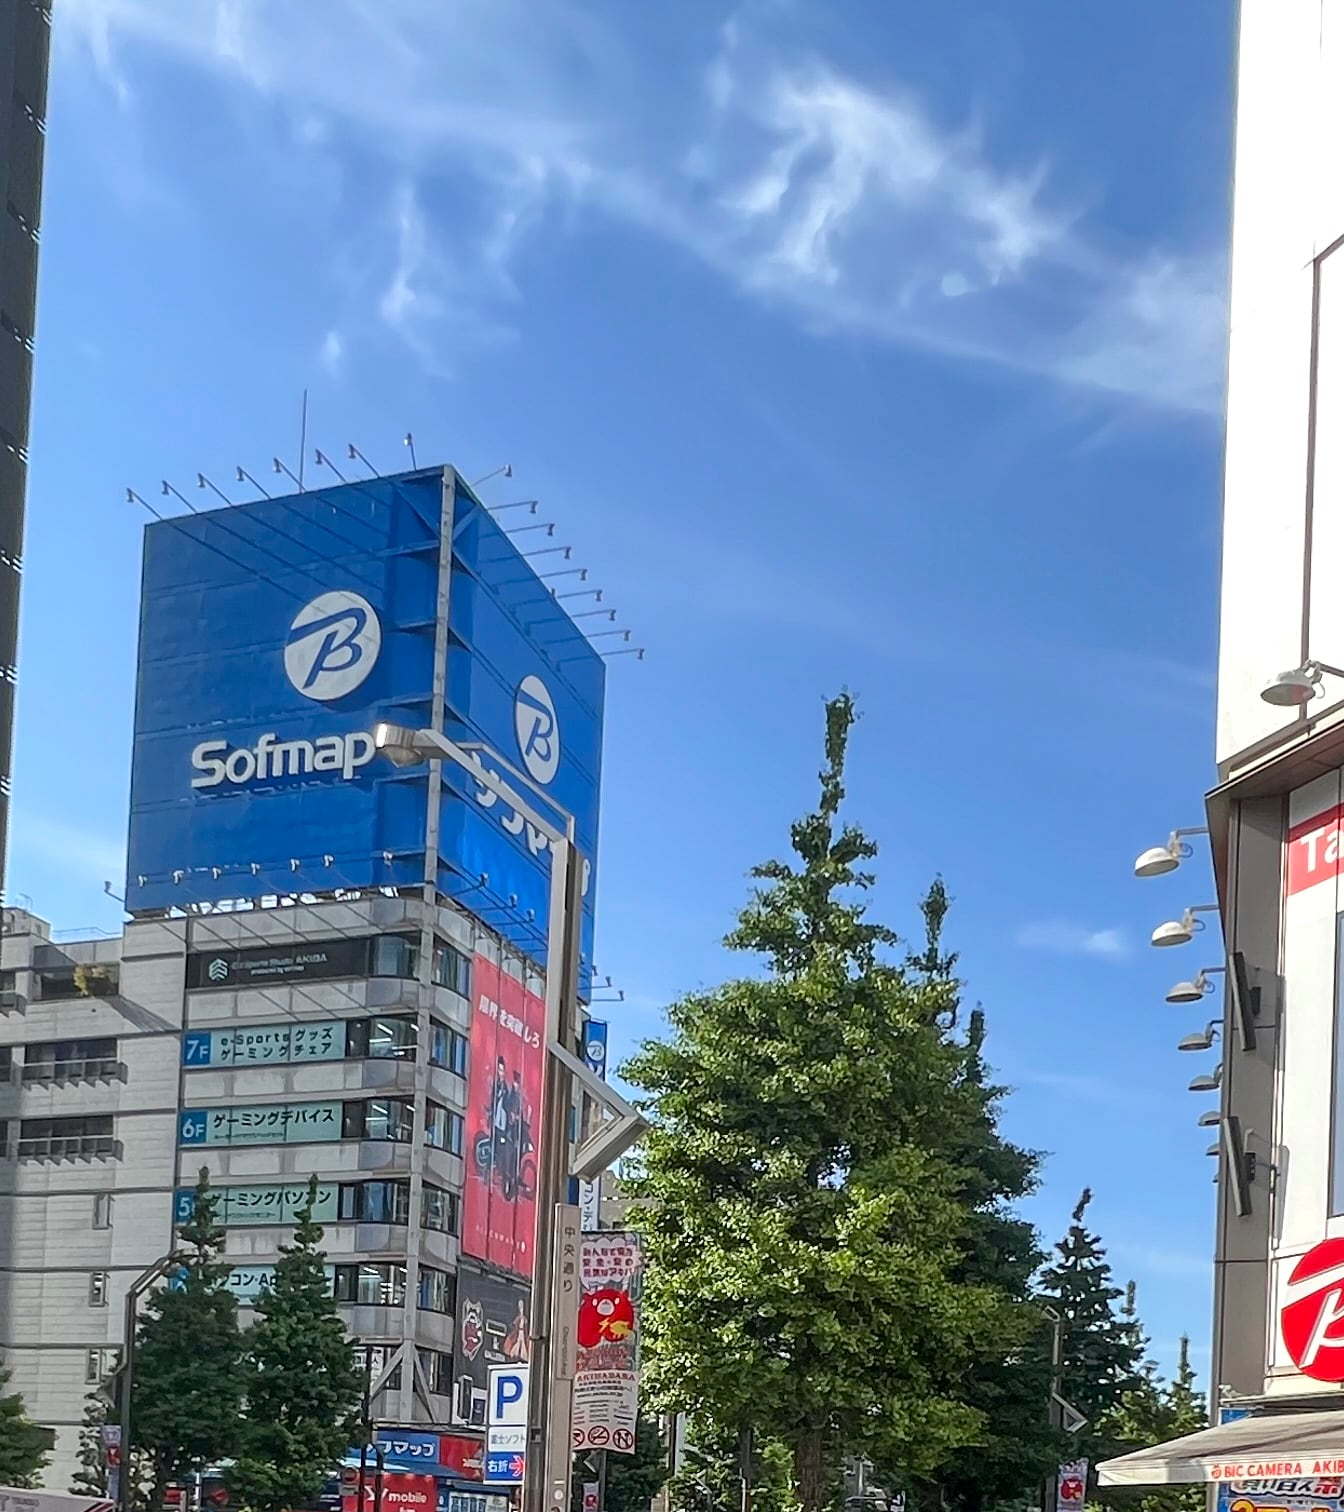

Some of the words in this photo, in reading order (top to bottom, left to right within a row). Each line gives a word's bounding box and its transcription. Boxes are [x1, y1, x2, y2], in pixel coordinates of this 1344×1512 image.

[190, 730, 376, 791] Sofmap
[294, 1027, 334, 1042] グッズ
[186, 1038, 209, 1061] 7F
[182, 1118, 206, 1140] 6F
[212, 1108, 336, 1130] ゲーミングデバイス
[562, 1225, 576, 1294] 中央通り
[496, 1375, 524, 1419] P
[490, 1434, 526, 1446] 富士ソフト
[487, 1459, 509, 1474] 右折
[1223, 1465, 1245, 1479] BIC
[1246, 1462, 1303, 1477] CAMERA
